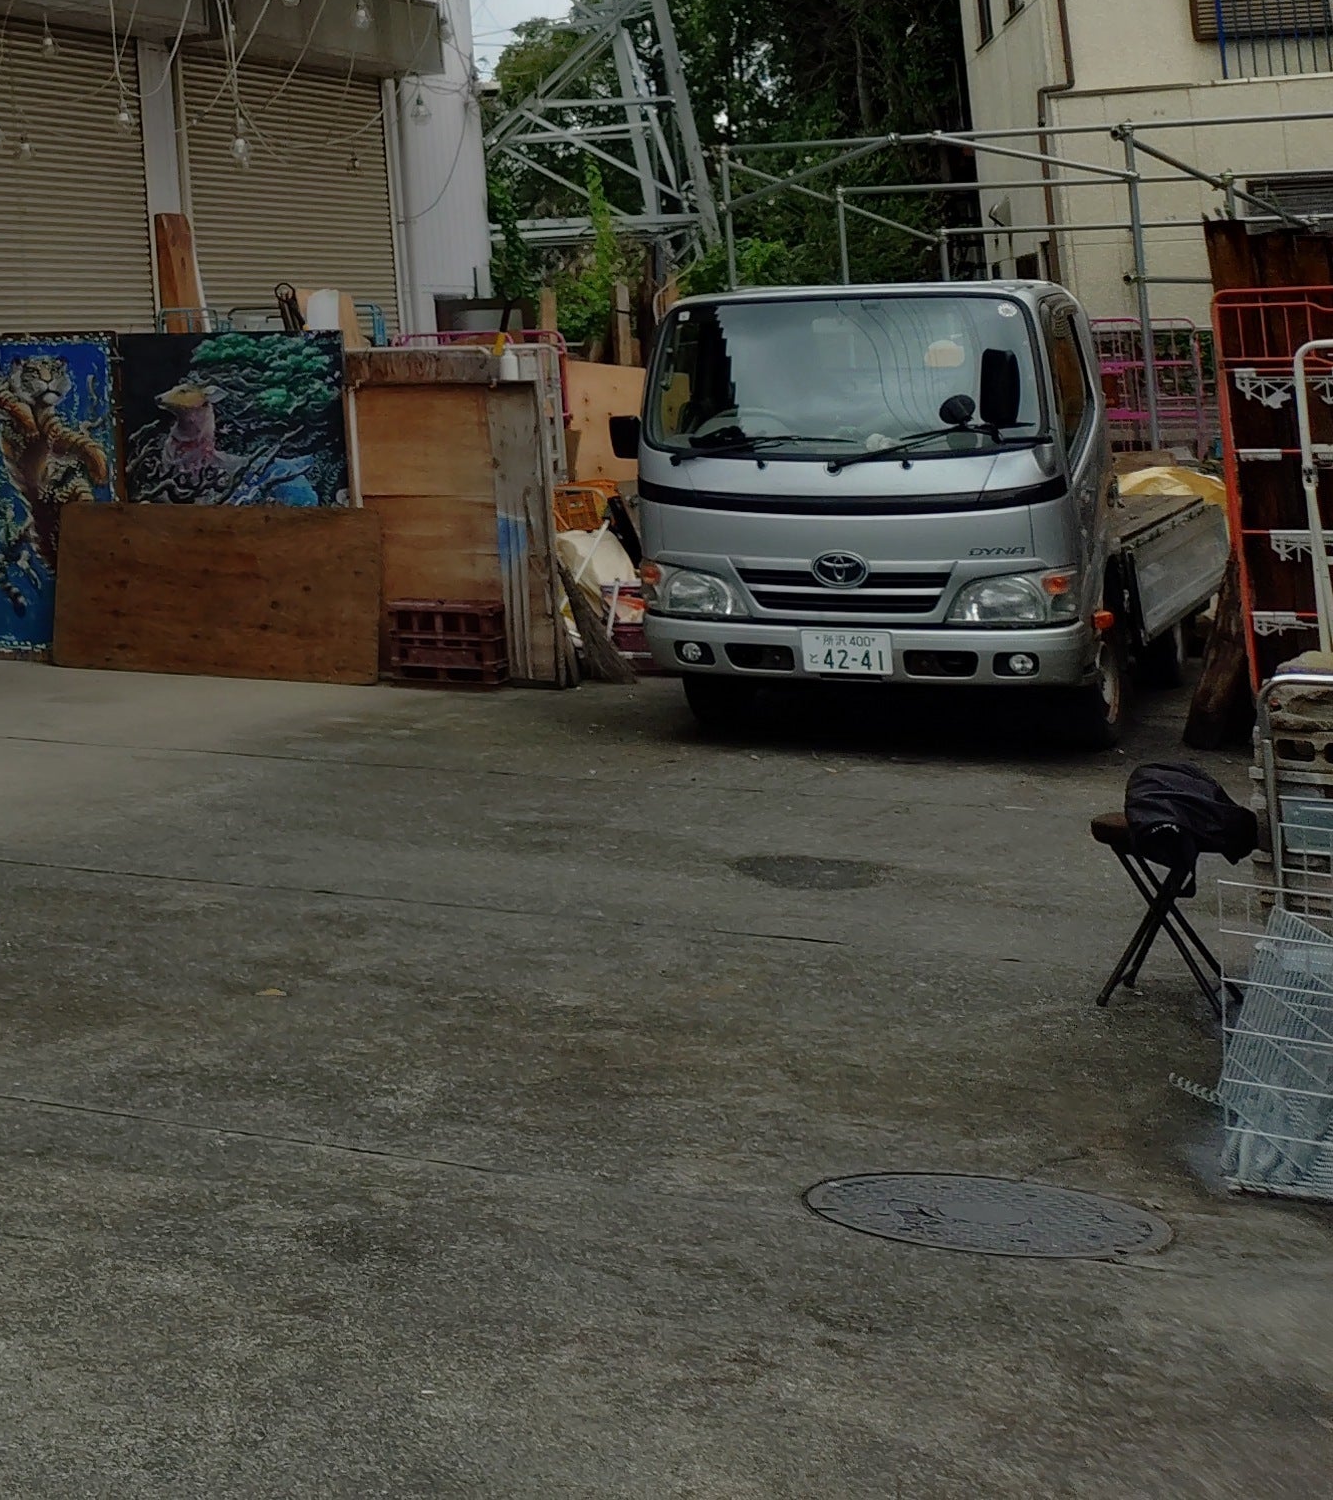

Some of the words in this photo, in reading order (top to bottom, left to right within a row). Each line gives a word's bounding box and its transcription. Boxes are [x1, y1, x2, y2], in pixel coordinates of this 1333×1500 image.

[969, 546, 1026, 556] DYNA
[822, 634, 848, 647] 所沢
[849, 635, 872, 647] 400
[809, 653, 819, 664] と
[823, 648, 884, 671] 42-41
